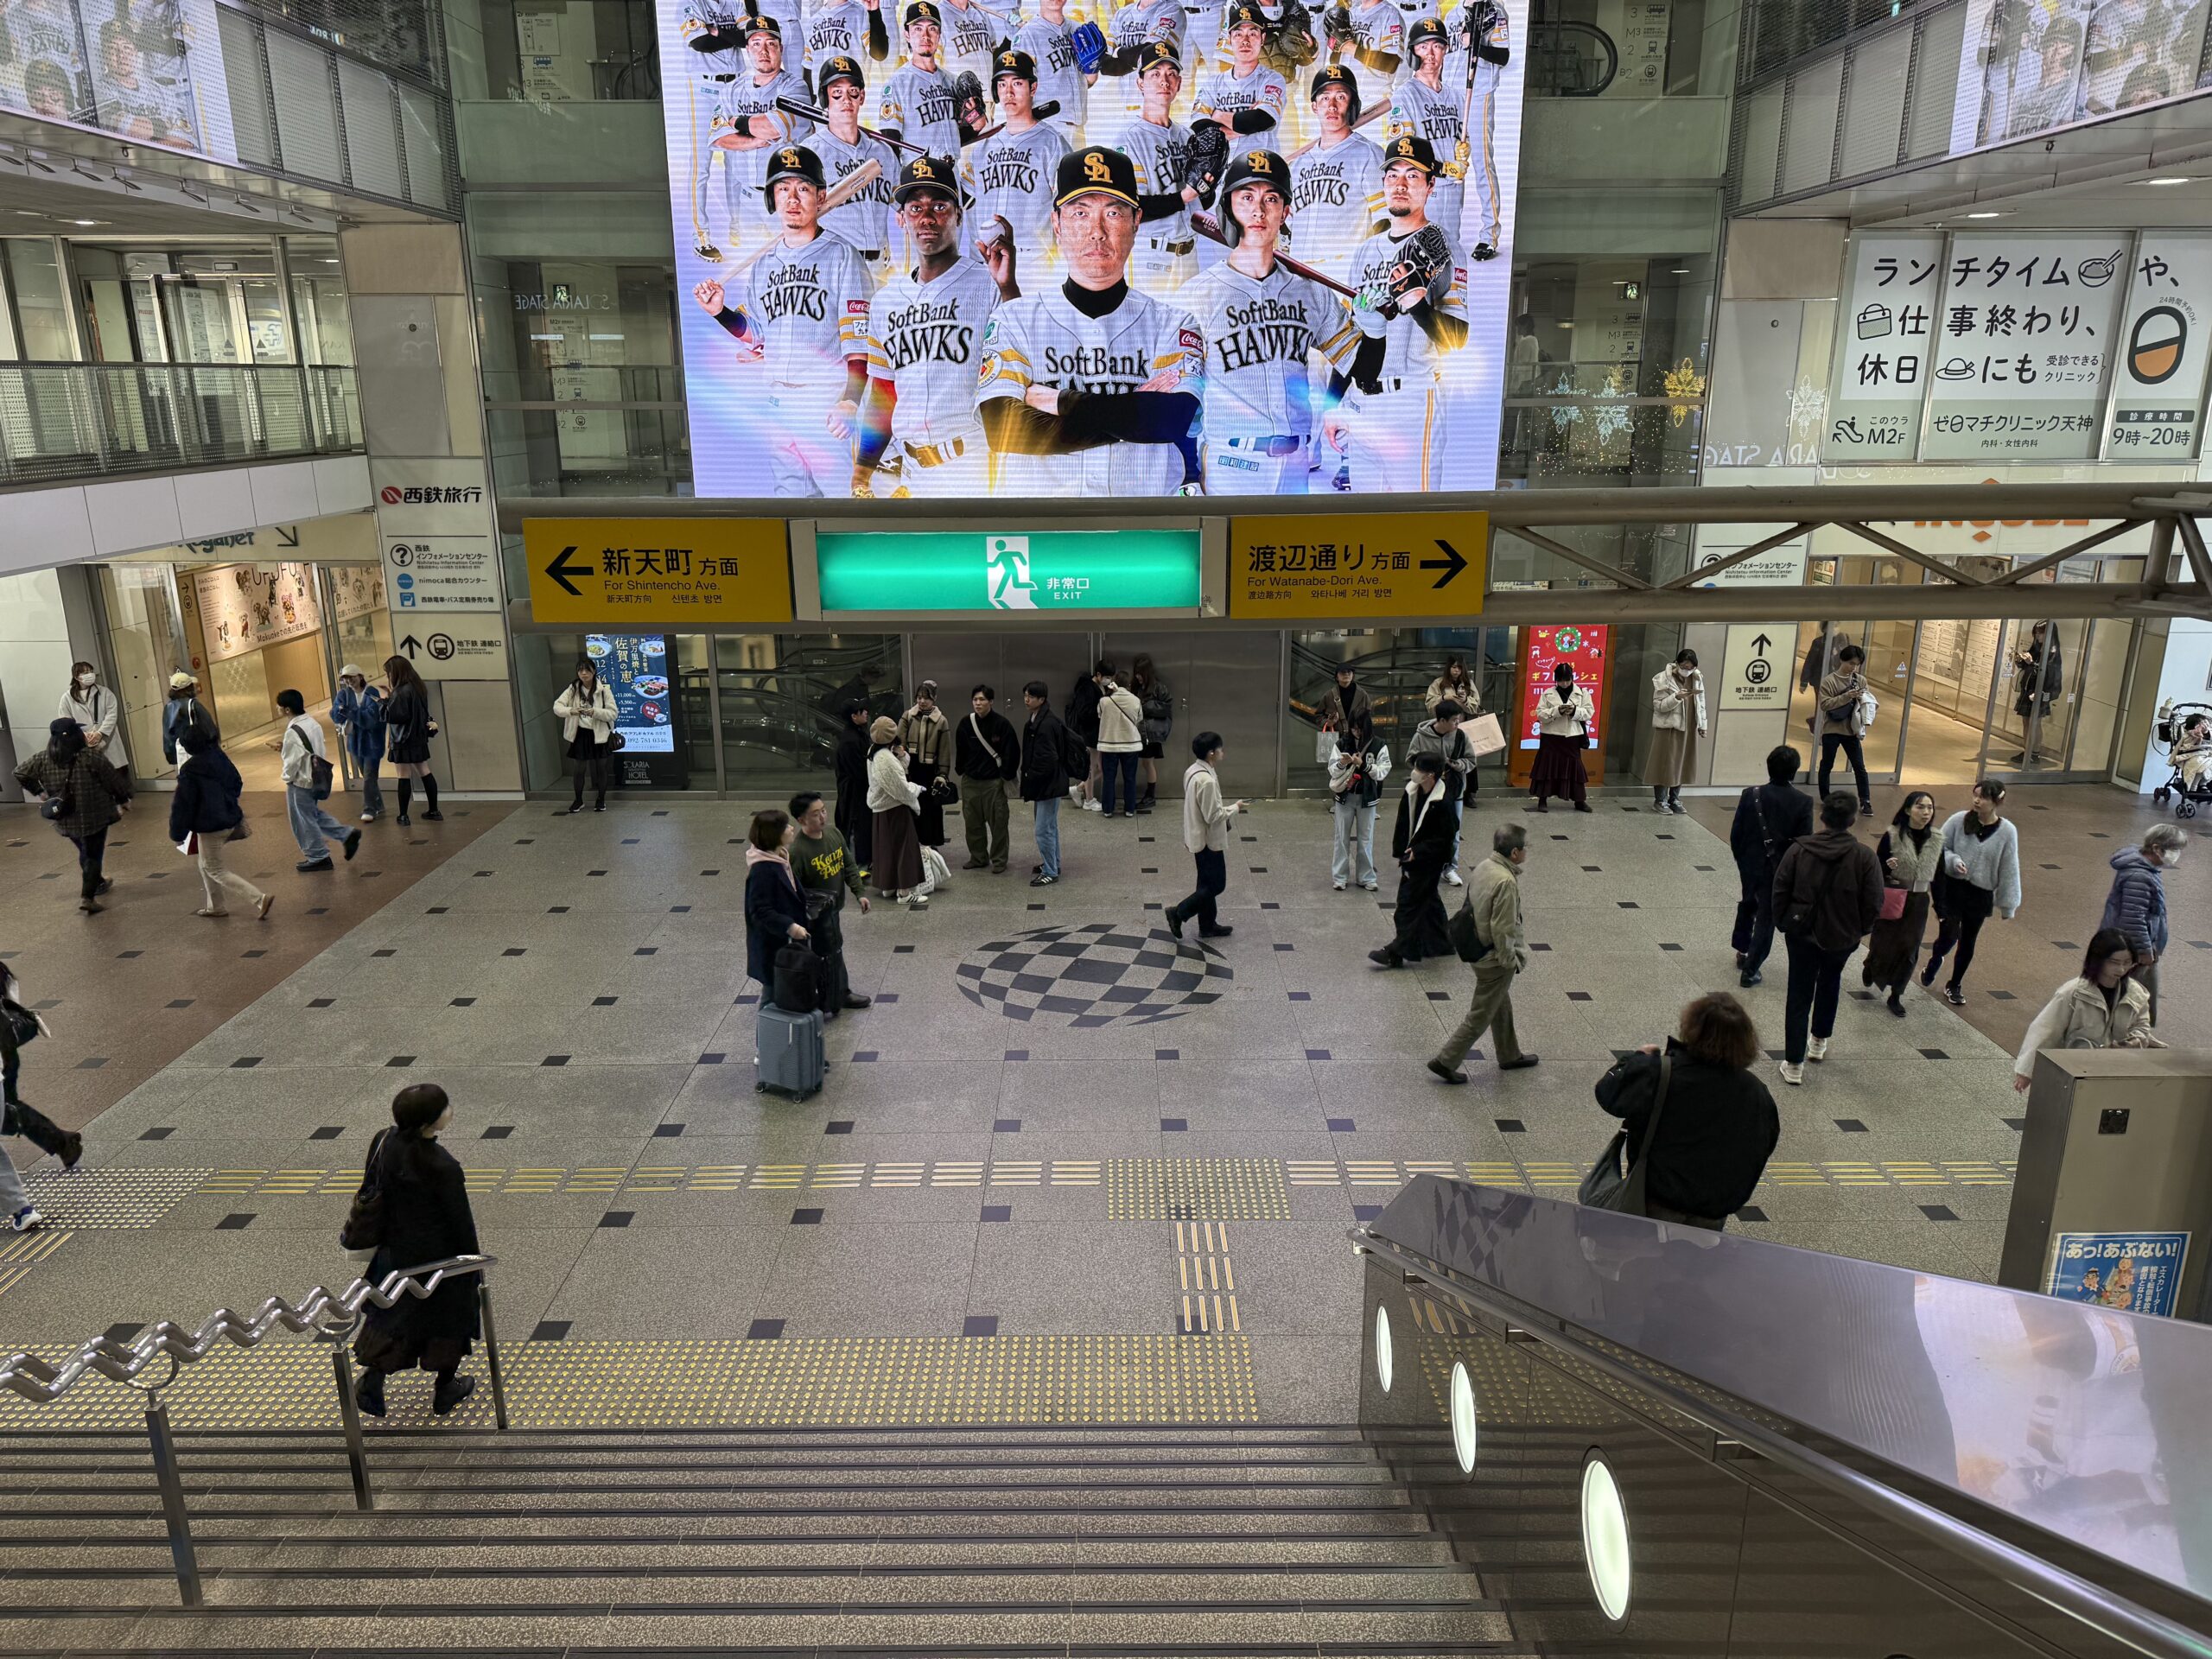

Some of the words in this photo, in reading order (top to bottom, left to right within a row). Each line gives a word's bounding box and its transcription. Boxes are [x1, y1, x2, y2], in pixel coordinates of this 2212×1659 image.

[813, 16, 848, 32] SoftBank
[954, 20, 988, 34] SoftBank
[810, 29, 852, 51] HAWKS
[918, 85, 957, 101] SoftBan
[1215, 90, 1256, 107] SoftBank
[737, 99, 777, 114] SoftBank
[916, 99, 960, 127] HAW
[1425, 104, 1459, 118] SoftBank
[987, 148, 1033, 168] SoftBank
[978, 162, 1040, 195] HAWKS
[1300, 162, 1345, 183] SoftBank
[1293, 179, 1350, 213] HAWKS
[767, 263, 821, 289] SoftBank
[1873, 255, 2069, 288] ランチタイム
[2139, 255, 2180, 288] や、
[760, 286, 828, 326] HAWKS
[1225, 297, 1308, 328] SoftBank
[888, 297, 960, 333] SoftBank
[1897, 304, 2095, 337] 仕事終わり、
[883, 325, 974, 371] HAWKS
[1046, 346, 1151, 379] SoftBank
[2046, 353, 2100, 367] 受診できる
[1857, 353, 1919, 385] 休日
[1981, 353, 2037, 385] にも
[2044, 371, 2096, 384] クリニック
[1869, 416, 1909, 426] このウラ
[2129, 411, 2183, 422] 診療時間
[1867, 428, 1906, 445] M2F
[1981, 438, 2038, 448] 内科・女性内科
[404, 486, 482, 504] 西鉄旅行
[605, 581, 623, 590] For
[626, 580, 692, 591] Shintencho
[695, 581, 721, 590] Ave.
[1046, 576, 1090, 590] 非常口
[1247, 576, 1268, 587] For
[1269, 575, 1354, 587] Watanabe-Dori
[1357, 575, 1382, 585] Ave.
[607, 594, 652, 604] 新天町方向
[703, 594, 723, 604] 방면
[1053, 591, 1082, 601] EXIT
[1351, 588, 1370, 598] 거리
[1374, 588, 1392, 598] 방면
[2065, 1242, 2178, 1259] あっ!あぶない!
